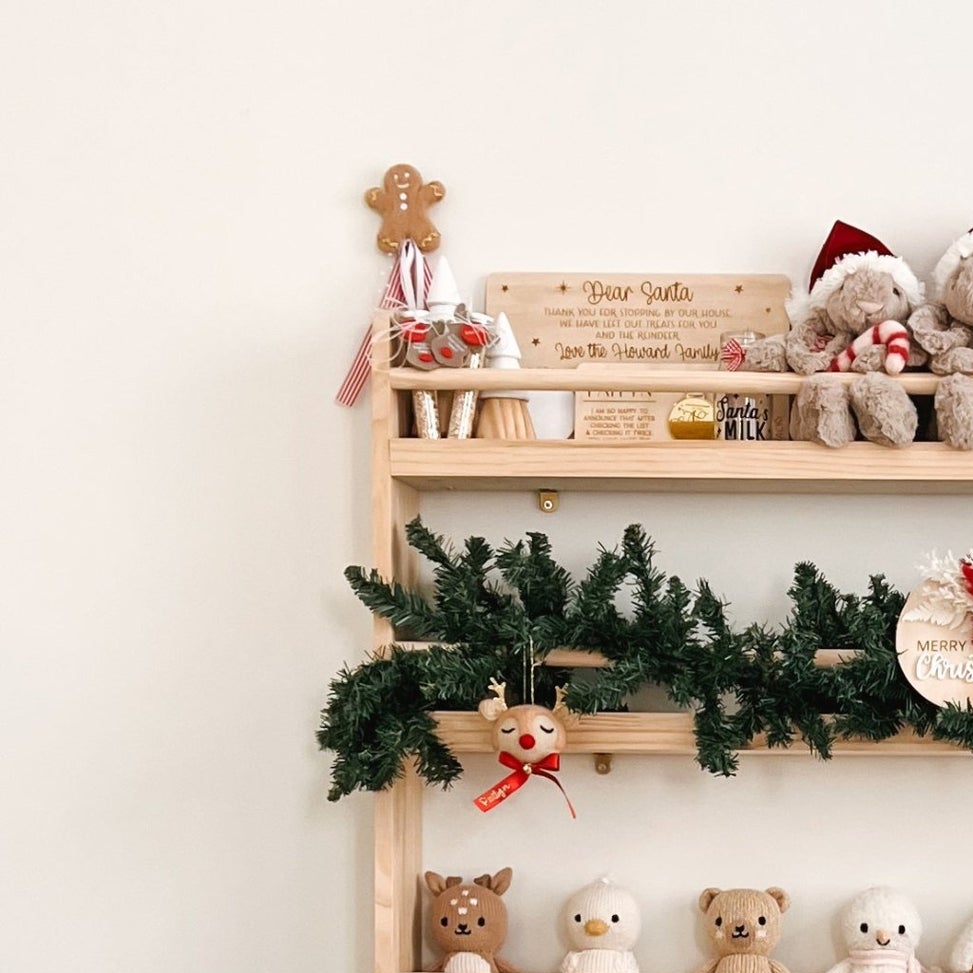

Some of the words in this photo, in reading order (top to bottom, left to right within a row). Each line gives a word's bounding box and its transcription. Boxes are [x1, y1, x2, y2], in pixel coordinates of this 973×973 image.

[582, 280, 634, 305] Dear
[640, 281, 694, 305] Santa
[544, 307, 575, 317] THANK
[577, 307, 597, 317] YOU
[600, 308, 618, 318] FOR
[620, 308, 661, 318] STOPPING
[664, 308, 676, 318] BY
[678, 308, 700, 319] OUR
[559, 319, 573, 329] WE
[576, 319, 599, 329] HAVE
[602, 320, 621, 329] LEFT
[624, 320, 643, 330] OUT
[646, 320, 676, 330] TREATS
[678, 320, 697, 330] FOR
[699, 320, 718, 330] YOU
[595, 331, 616, 340] AND
[619, 331, 634, 340] THE
[637, 331, 681, 341] REINDEER
[554, 342, 585, 361] Love
[587, 343, 607, 359] the
[611, 343, 671, 362] Howard
[674, 343, 721, 362] Family
[724, 421, 766, 441] MILK
[916, 640, 967, 651] MERRY
